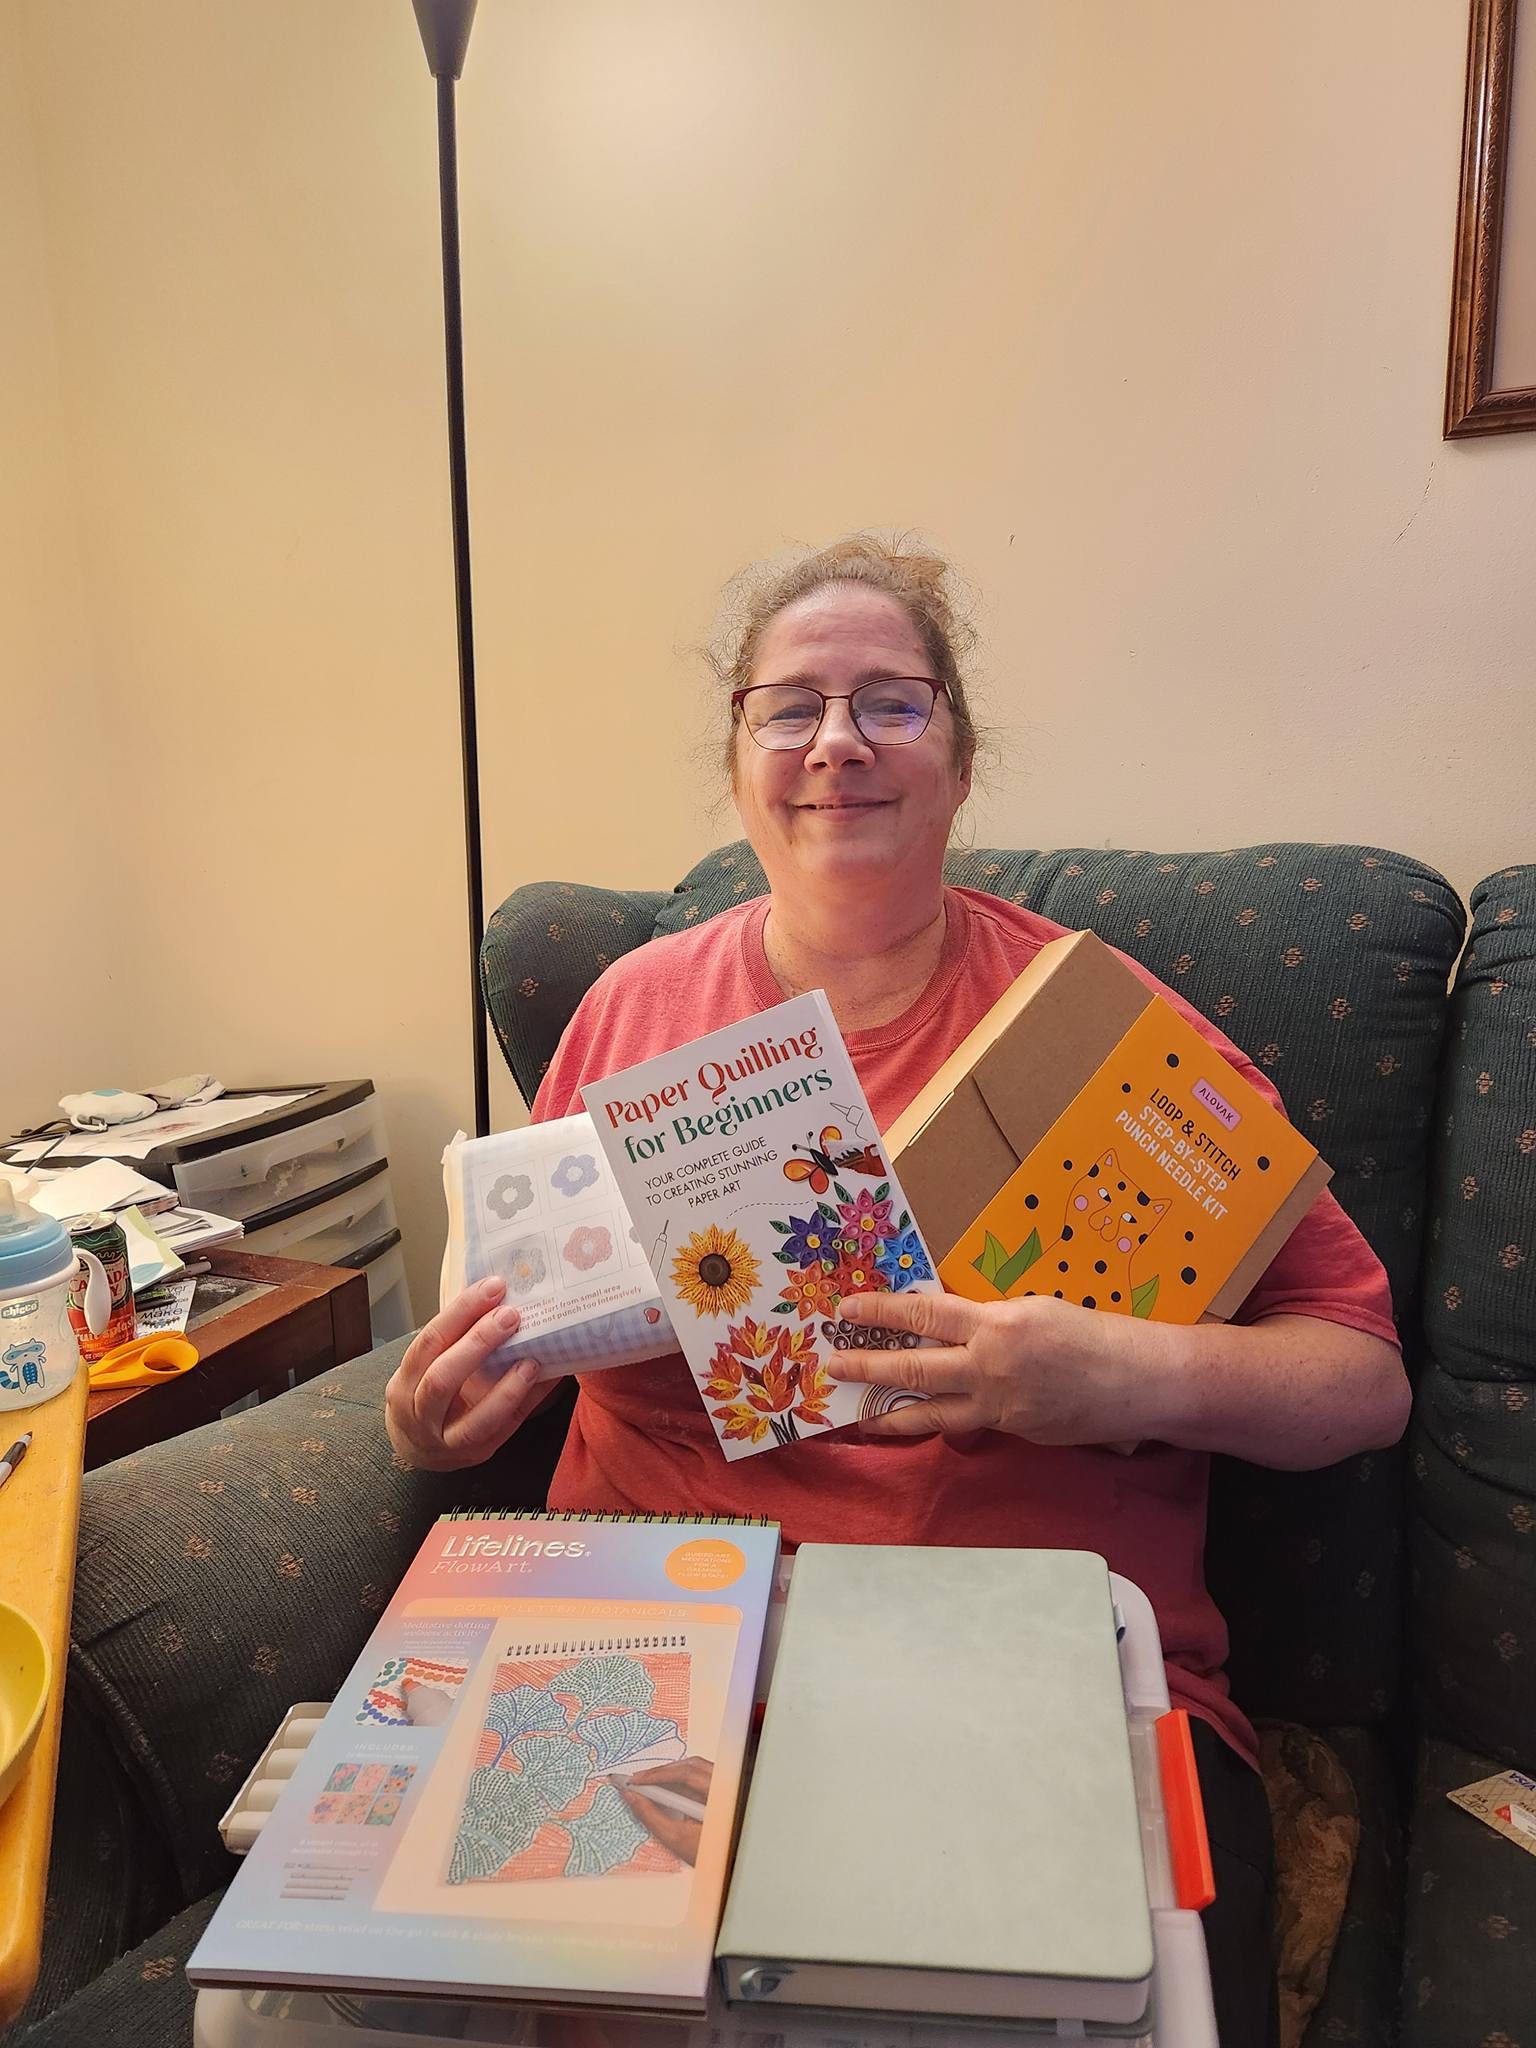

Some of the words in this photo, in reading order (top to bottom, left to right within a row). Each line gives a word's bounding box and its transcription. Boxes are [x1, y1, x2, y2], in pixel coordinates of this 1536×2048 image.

[604, 1078, 689, 1129] Paper
[697, 1026, 824, 1106] Quilling
[623, 1130, 666, 1164] for
[671, 1069, 833, 1145] Beginners
[1199, 1086, 1235, 1123] ALOVAK
[1139, 1105, 1228, 1193] STEP-BY-STEP
[1149, 1087, 1184, 1122] LOOP
[1181, 1119, 1196, 1138] &
[1194, 1133, 1241, 1181] STITCH
[644, 1171, 676, 1190] YOUR
[676, 1150, 731, 1178] COMPLETE
[731, 1136, 767, 1157] GUIDE
[646, 1193, 662, 1207] TO
[663, 1173, 716, 1200] CREATING
[717, 1149, 778, 1180] STUNNING
[1115, 1110, 1160, 1156] PUNCH
[1156, 1150, 1206, 1202] NEEDLE
[1202, 1197, 1228, 1221] KIT
[687, 1189, 720, 1208] PAPER
[722, 1180, 742, 1197] ART
[68, 1270, 129, 1292] CAADA
[580, 1288, 602, 1302] small
[2, 1301, 38, 1318] chicco
[556, 1305, 582, 1320] punch
[440, 1535, 587, 1558] Lifelines
[591, 1605, 688, 1617] BOTANICALS
